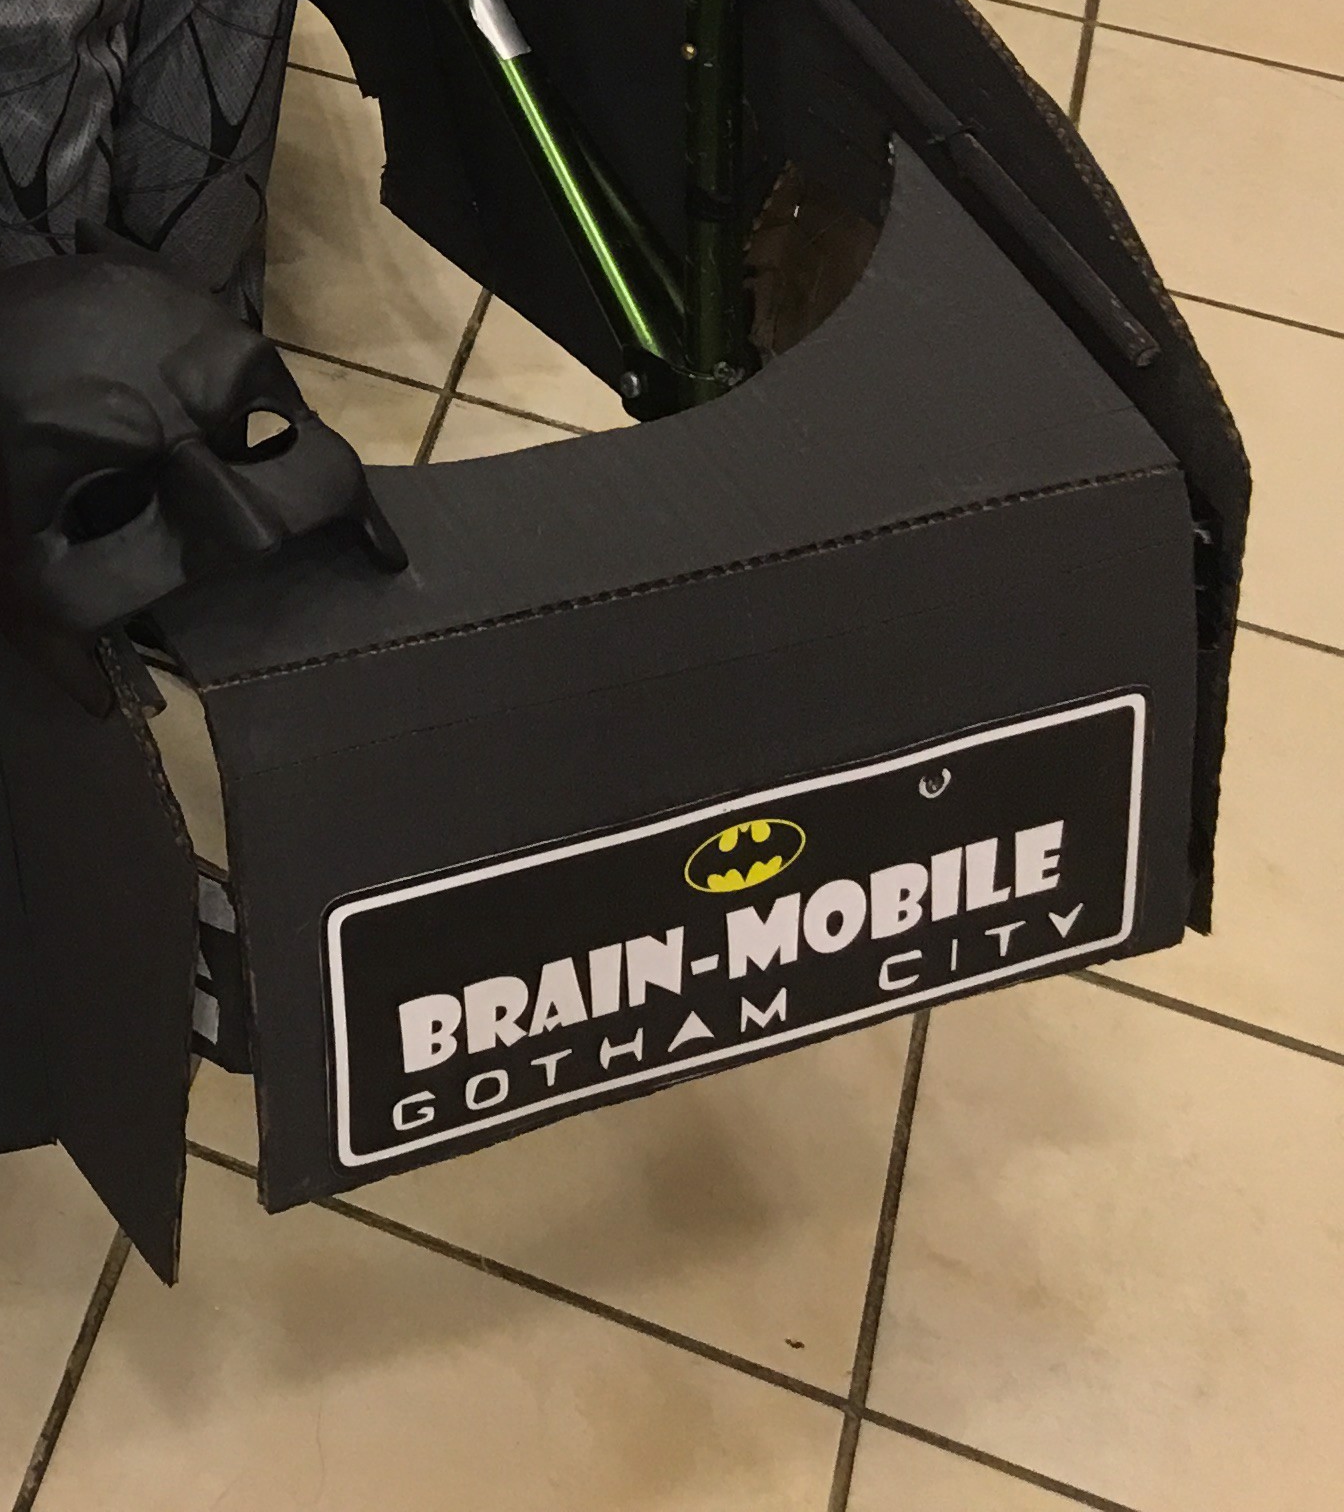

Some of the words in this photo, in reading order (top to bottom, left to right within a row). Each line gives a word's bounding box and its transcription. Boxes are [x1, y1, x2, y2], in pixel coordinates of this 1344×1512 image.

[392, 986, 787, 1131] GOTHAM
[878, 902, 1084, 991] CITY
[398, 819, 1065, 1074] BRAIN-MOBILE
